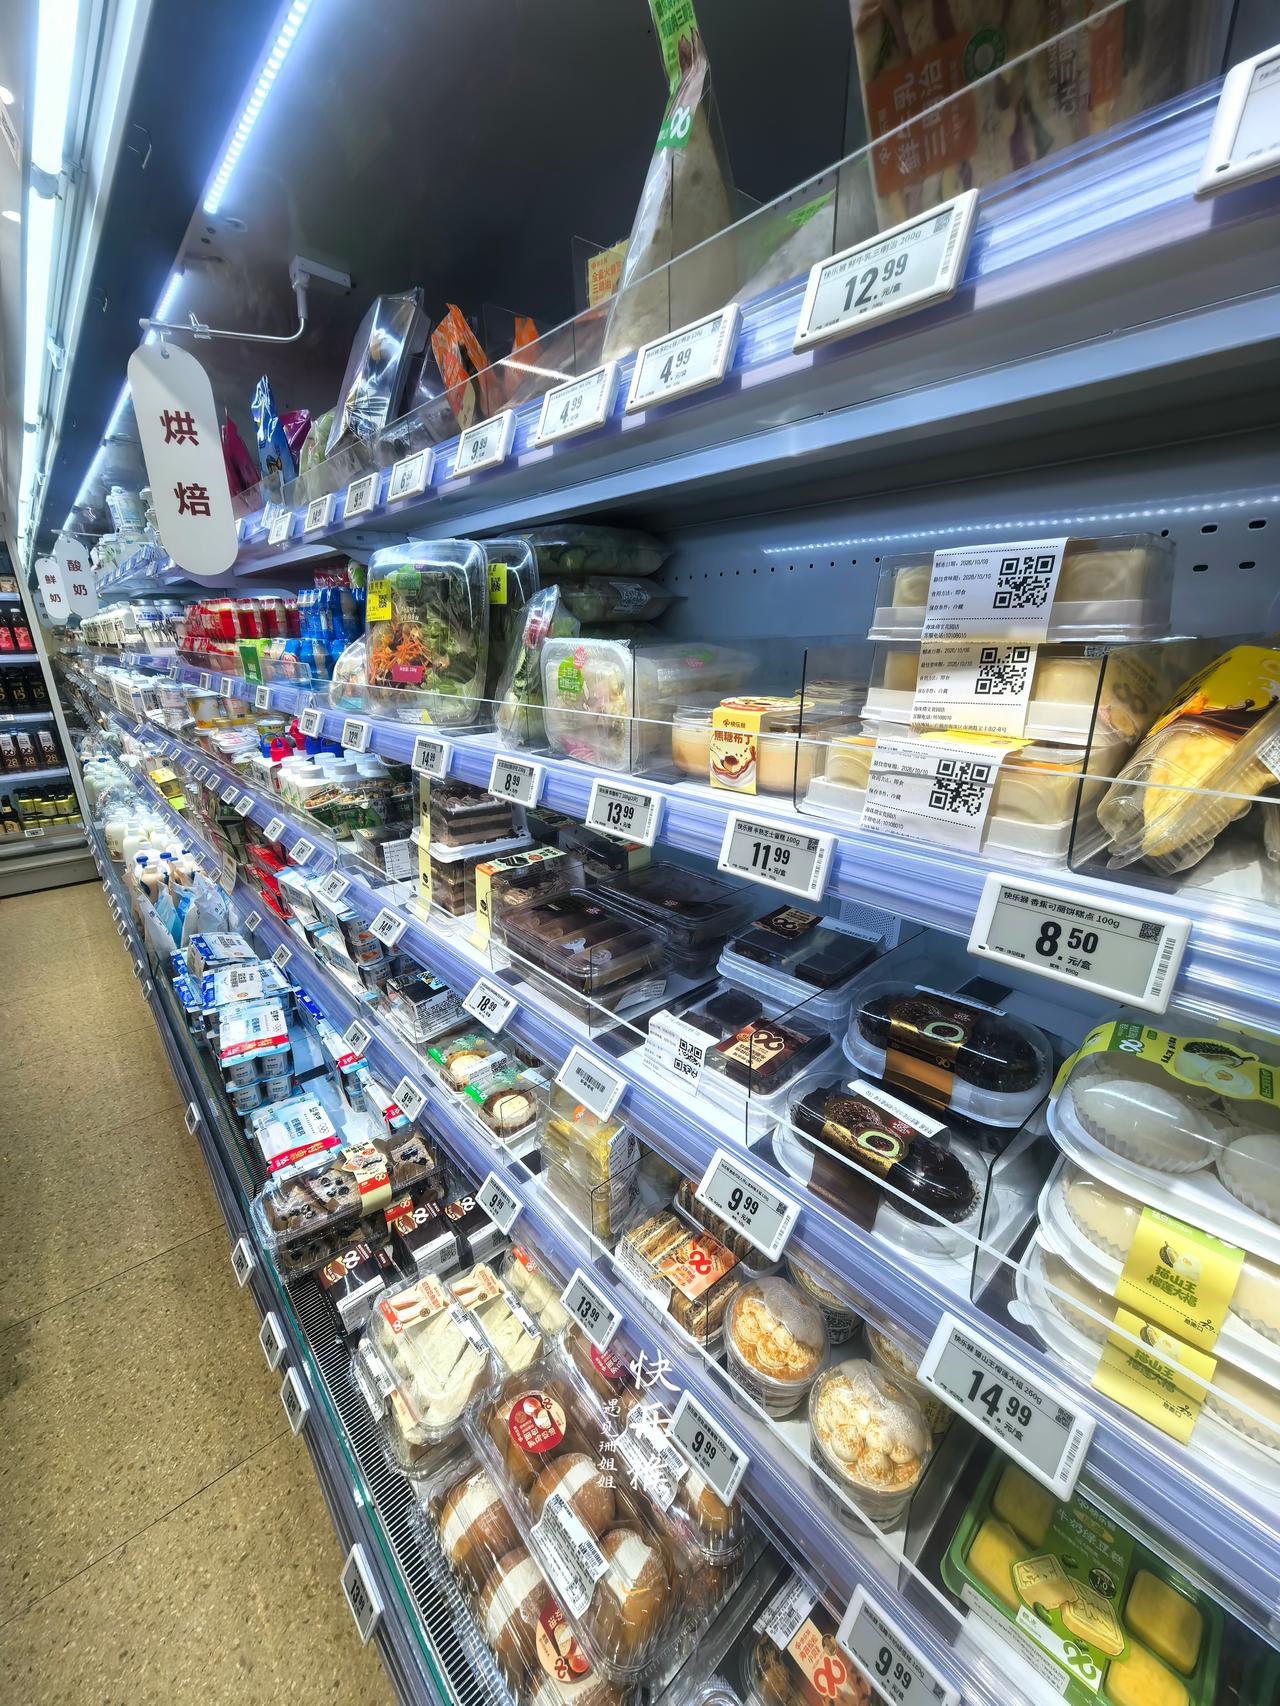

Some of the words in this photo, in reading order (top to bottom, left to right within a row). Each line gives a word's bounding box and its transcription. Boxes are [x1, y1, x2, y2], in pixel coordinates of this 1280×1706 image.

[841, 252, 909, 313] 12.99
[660, 347, 693, 385] 4.99
[559, 393, 584, 423] 4.99
[160, 409, 211, 517] 烘焙
[472, 436, 488, 461] 9.99
[67, 558, 88, 598] 酸奶
[421, 750, 436, 767] 14.99
[504, 772, 521, 792] 8.99
[607, 801, 635, 826] 13.99
[752, 842, 791, 872] 11.99
[1003, 891, 1030, 905] 快乐猴
[1030, 898, 1094, 922] 香蕉可丽饼糕点
[1096, 915, 1120, 929] 100g
[1035, 920, 1099, 961] 8.50
[1067, 955, 1092, 971] 元/盒
[477, 995, 497, 1013] 18.99
[489, 1193, 504, 1210] 9.99
[728, 1187, 759, 1215] 9.99
[1155, 1264, 1197, 1294] 猫山王
[576, 1296, 600, 1322] 13.99
[966, 1369, 1033, 1428] 14.99
[691, 1431, 717, 1460] 9.99
[875, 1645, 913, 1690] 9.99
